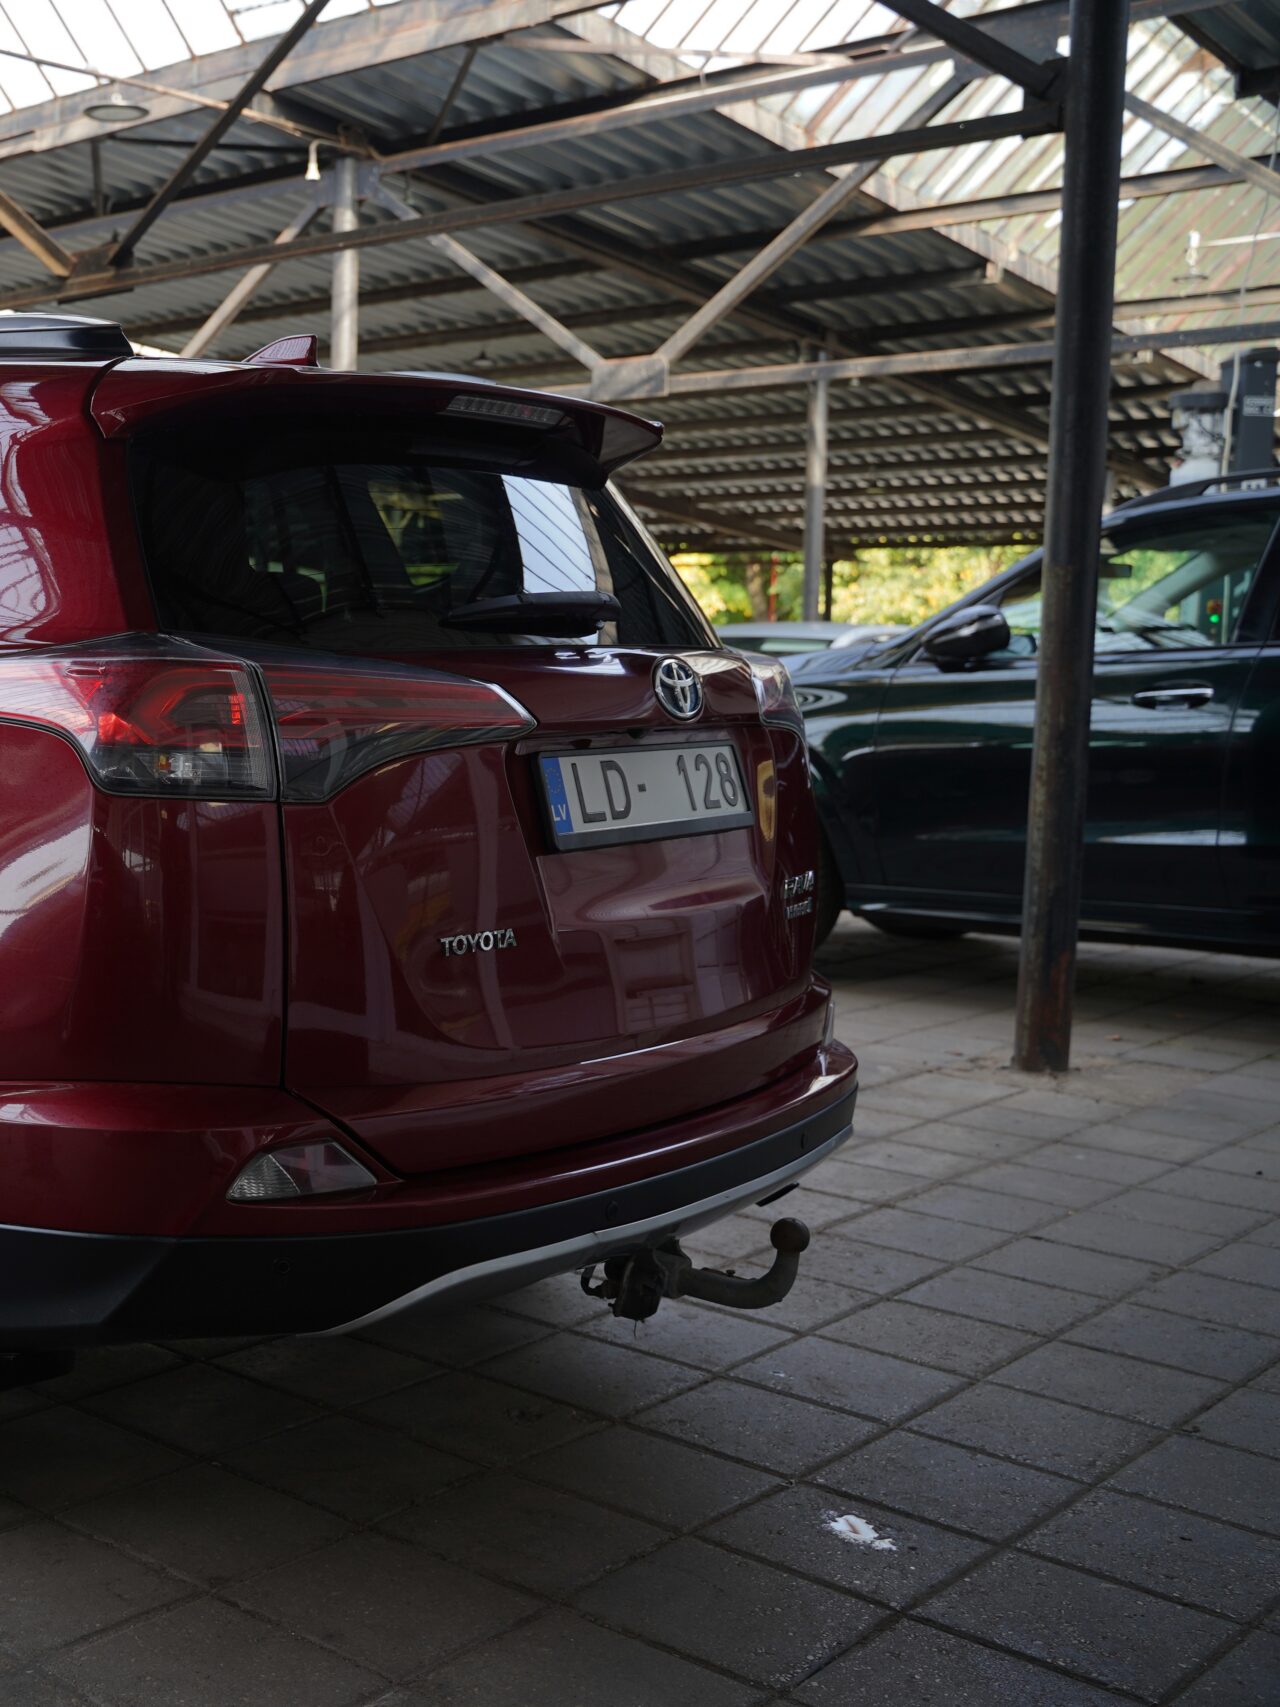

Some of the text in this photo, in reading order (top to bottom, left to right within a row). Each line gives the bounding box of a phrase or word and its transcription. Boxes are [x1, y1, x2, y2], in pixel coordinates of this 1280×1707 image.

[676, 751, 739, 811] 128
[551, 803, 568, 822] LV
[440, 928, 517, 957] TOYOTA
